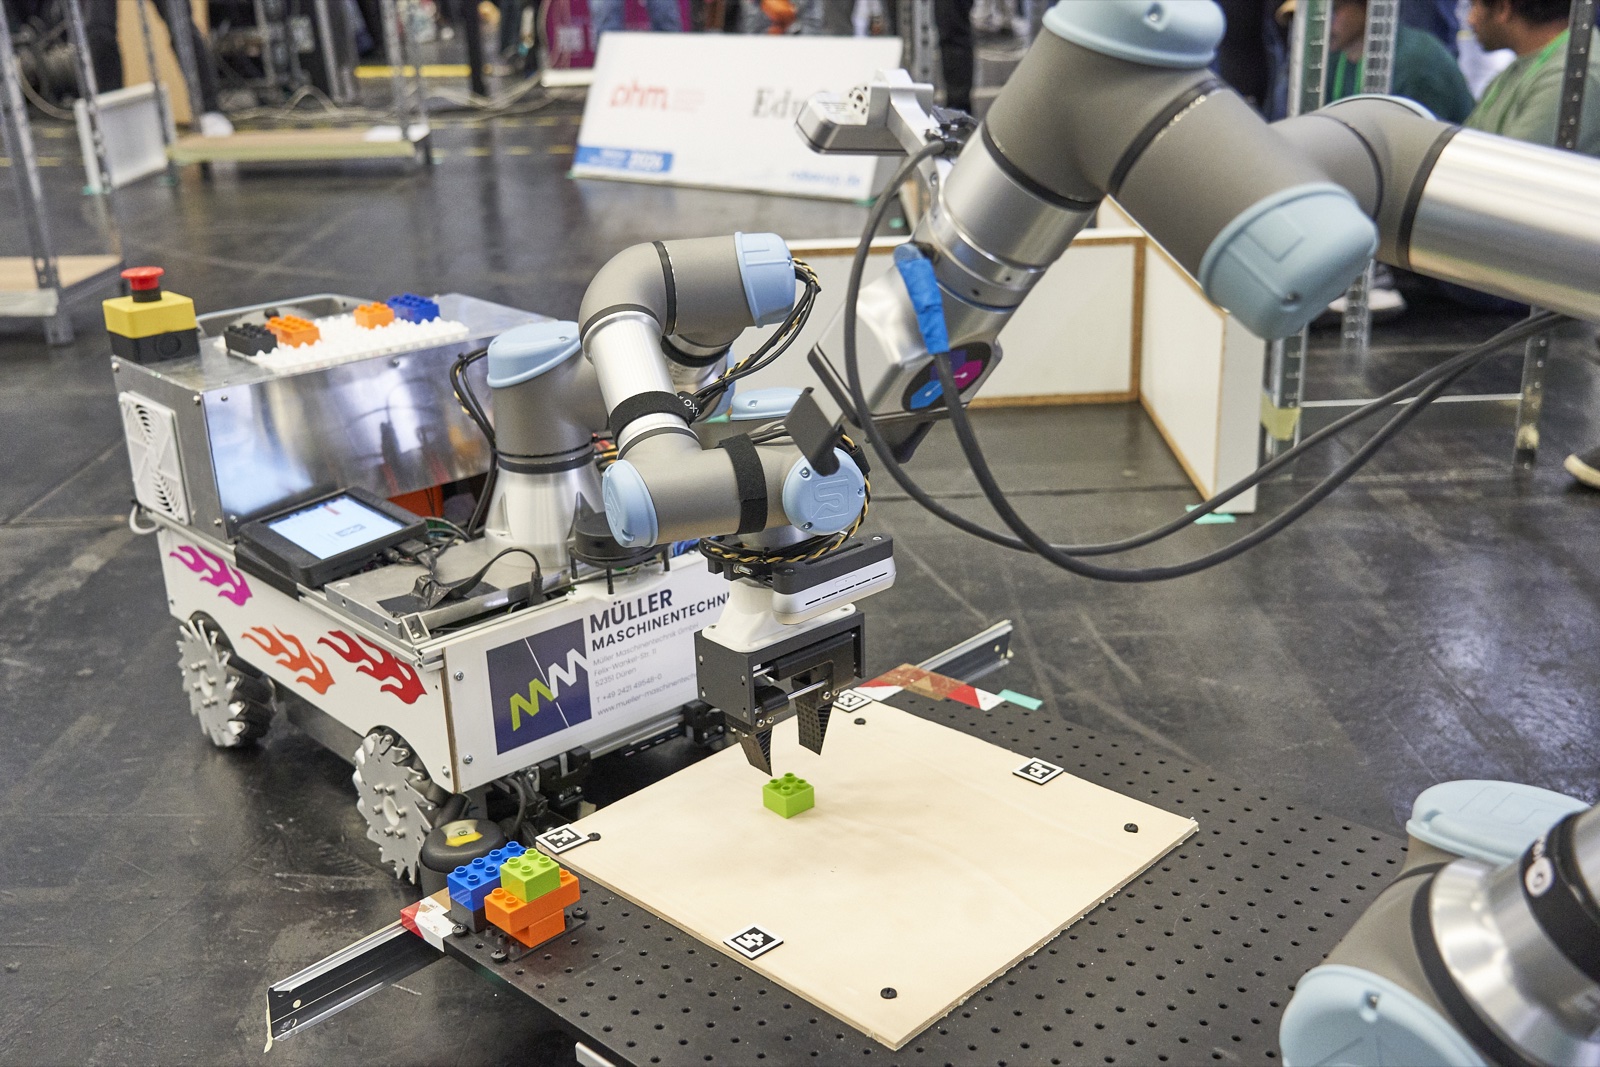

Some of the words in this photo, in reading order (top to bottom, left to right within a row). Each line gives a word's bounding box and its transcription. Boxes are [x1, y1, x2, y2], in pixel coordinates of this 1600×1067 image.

[590, 588, 673, 634] MÜLLER
[593, 654, 614, 667] Müller
[615, 632, 676, 658] Maschinentechnik
[677, 623, 699, 636] GmbH
[615, 667, 637, 680] Düren
[603, 690, 616, 700] +49
